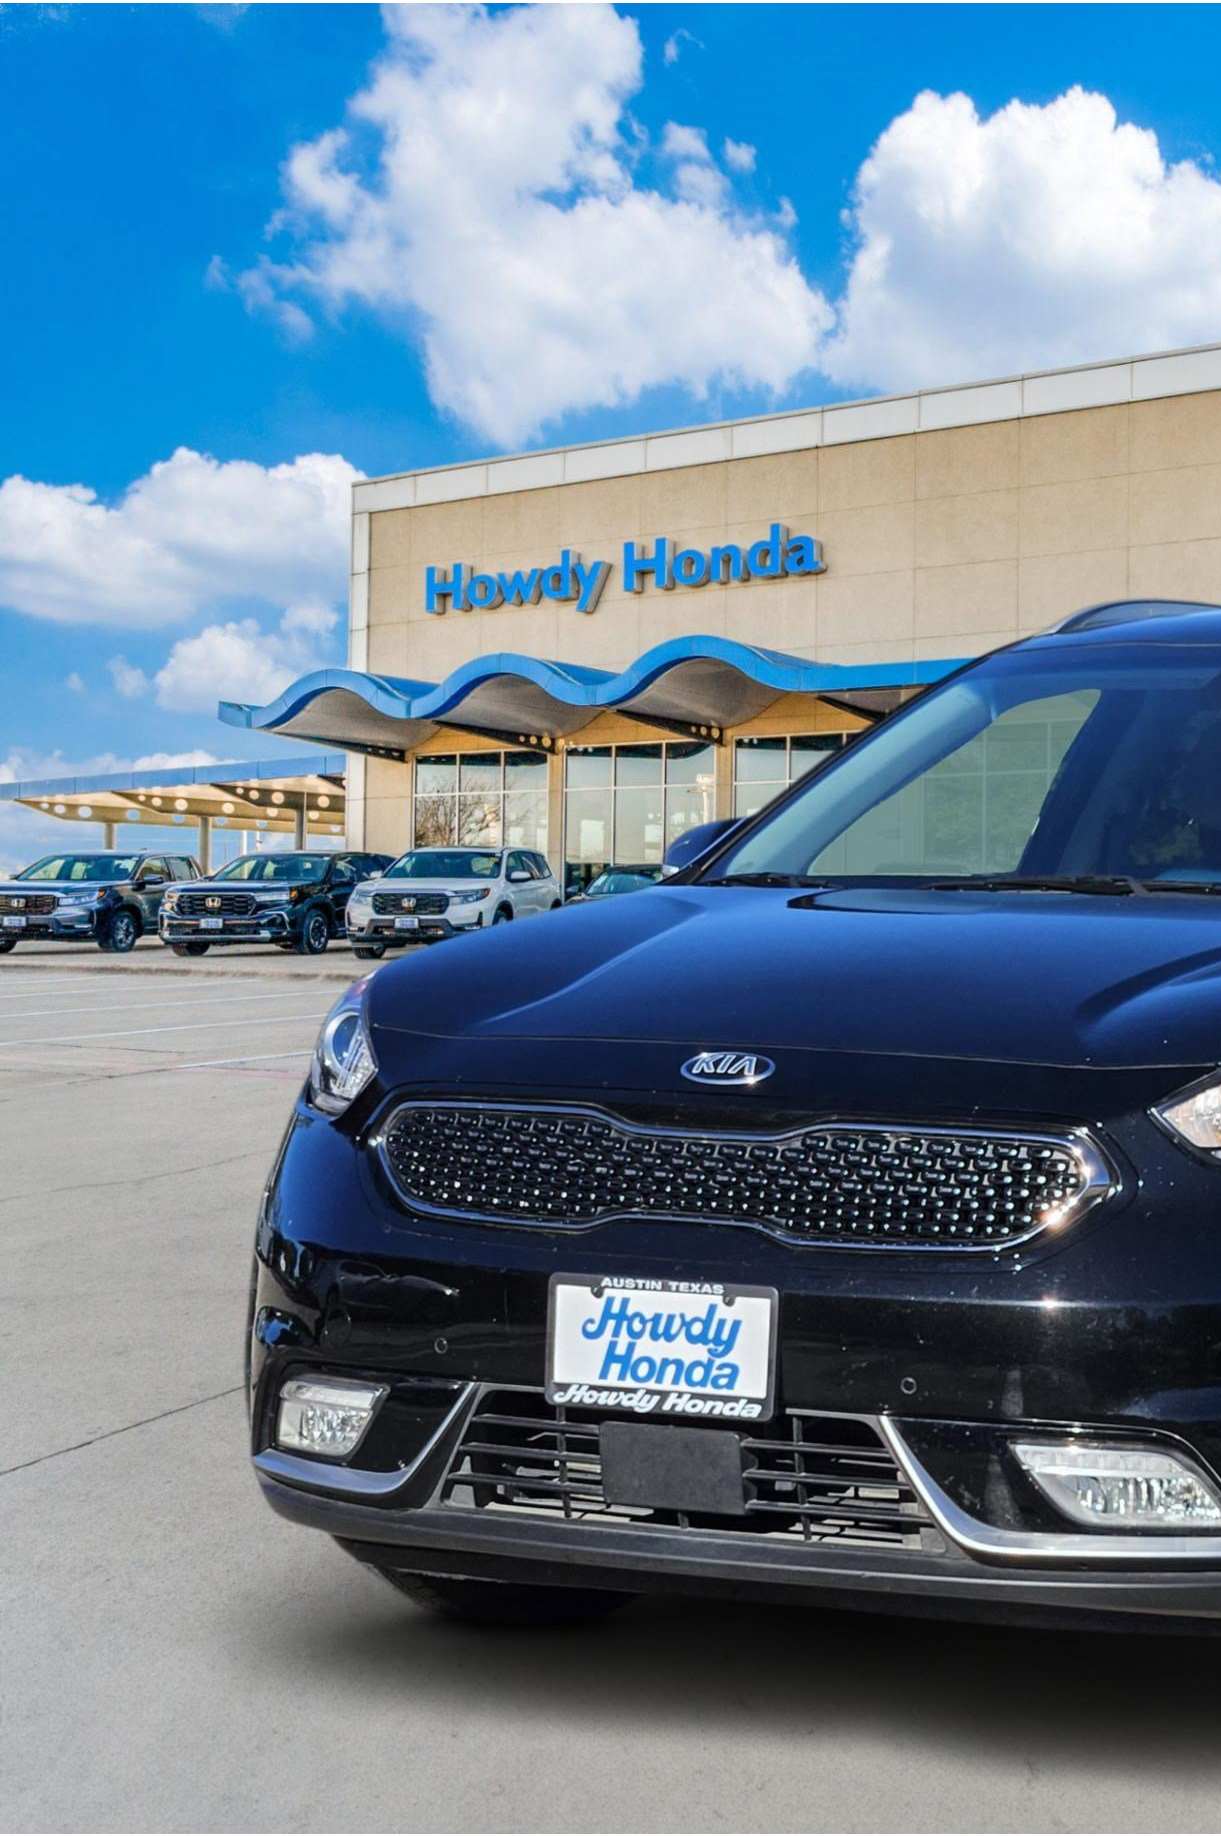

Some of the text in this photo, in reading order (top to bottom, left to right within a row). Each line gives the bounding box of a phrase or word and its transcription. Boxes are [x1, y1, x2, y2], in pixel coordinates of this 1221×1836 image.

[424, 522, 828, 614] Howdy Honda
[691, 1054, 757, 1076] KIA
[601, 1277, 725, 1295] AUSTIN TEXAS
[581, 1296, 743, 1359] Howdy
[598, 1340, 741, 1391] Honda
[553, 1384, 763, 1419] Howdy Honda
